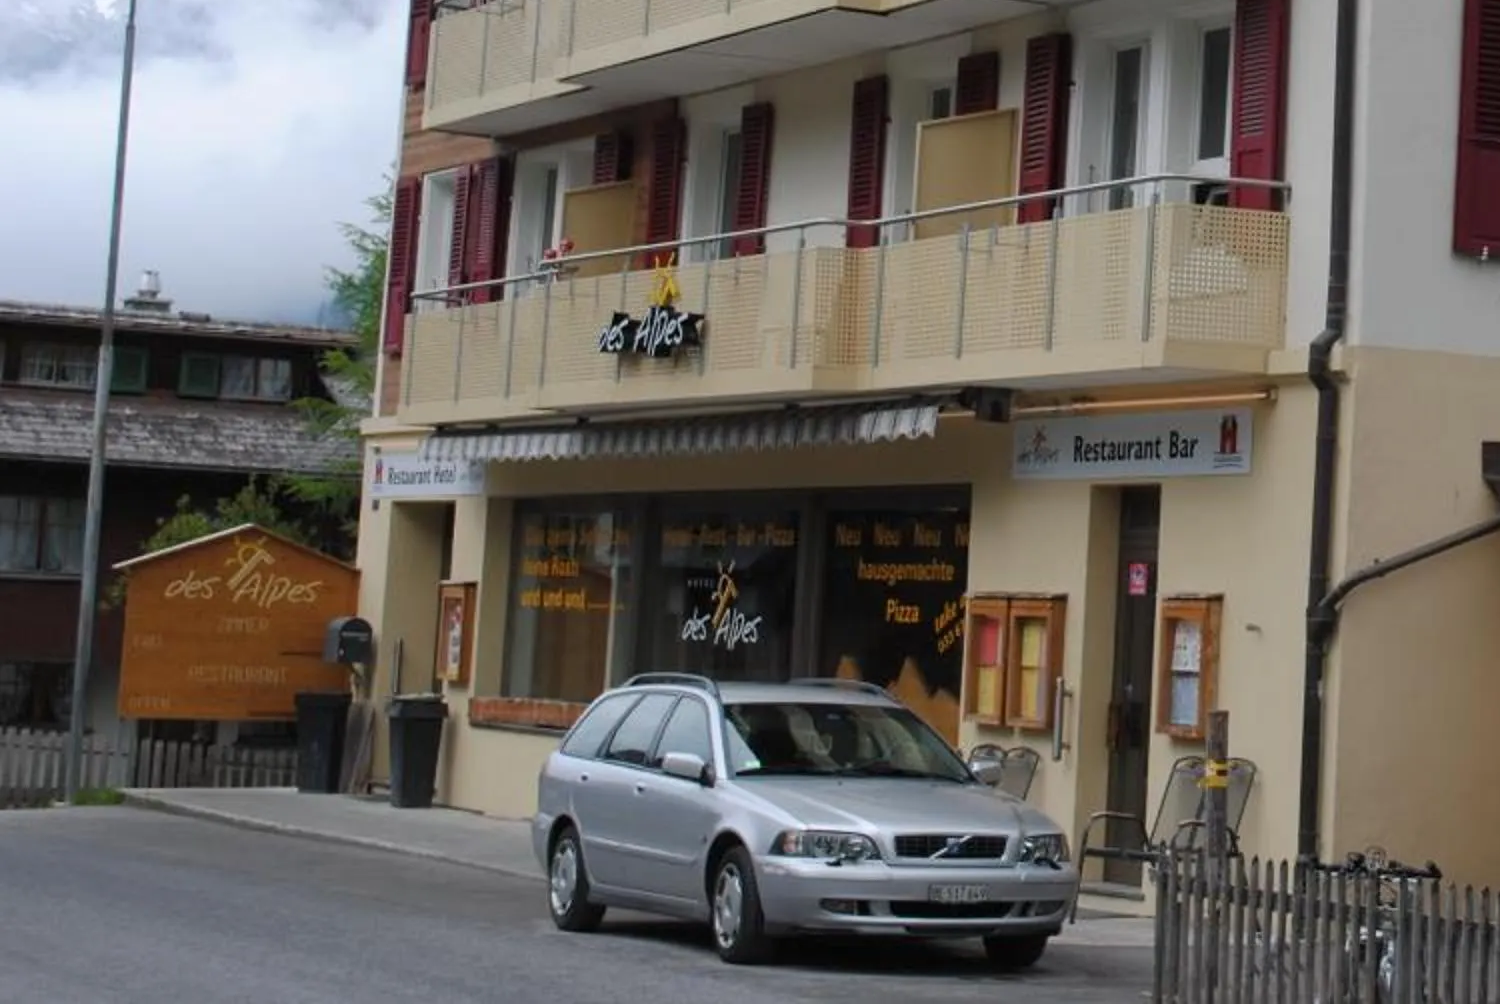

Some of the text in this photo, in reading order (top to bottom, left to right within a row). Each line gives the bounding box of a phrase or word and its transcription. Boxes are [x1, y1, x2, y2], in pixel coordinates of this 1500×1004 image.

[633, 307, 689, 357] Alpes
[1073, 429, 1199, 463] Restaurant Bar
[387, 467, 432, 485] Restaurant
[836, 522, 862, 547] Neu
[873, 522, 900, 546] Neu
[913, 522, 942, 547] Neu
[858, 556, 955, 587] hausgemachte
[164, 570, 323, 609] des Alpes
[886, 598, 919, 624] Pizza
[681, 607, 763, 651] des Alpes
